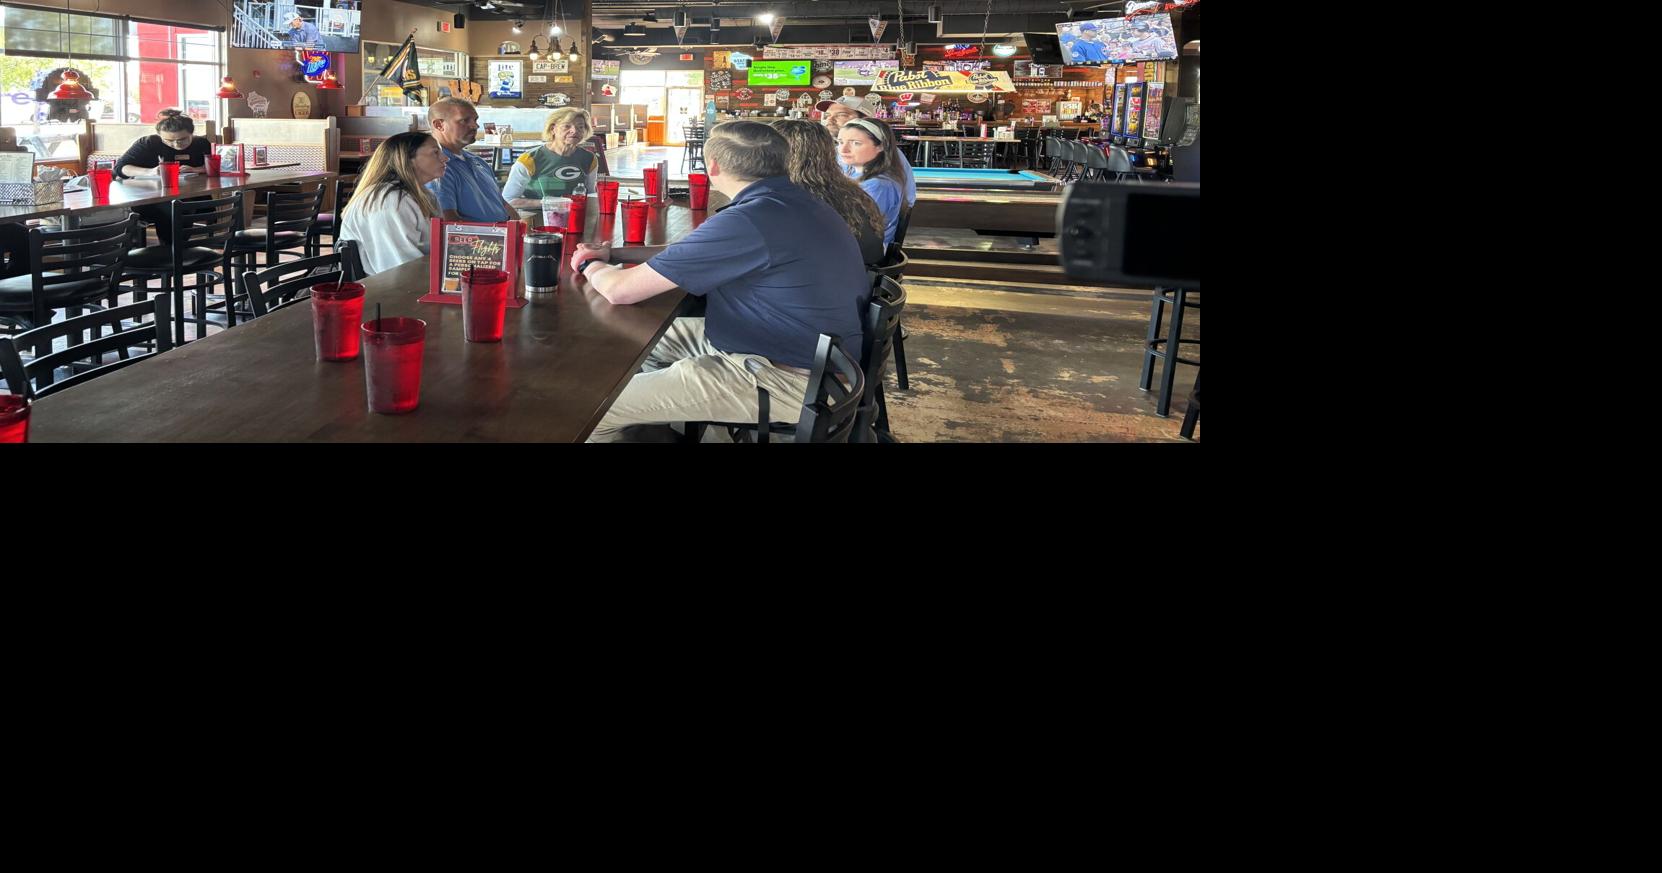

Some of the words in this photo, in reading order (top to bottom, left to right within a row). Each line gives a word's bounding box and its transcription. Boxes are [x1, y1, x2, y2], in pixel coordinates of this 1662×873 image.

[893, 70, 928, 82] Pabst
[906, 79, 951, 91] Ribbon
[554, 166, 581, 180] G
